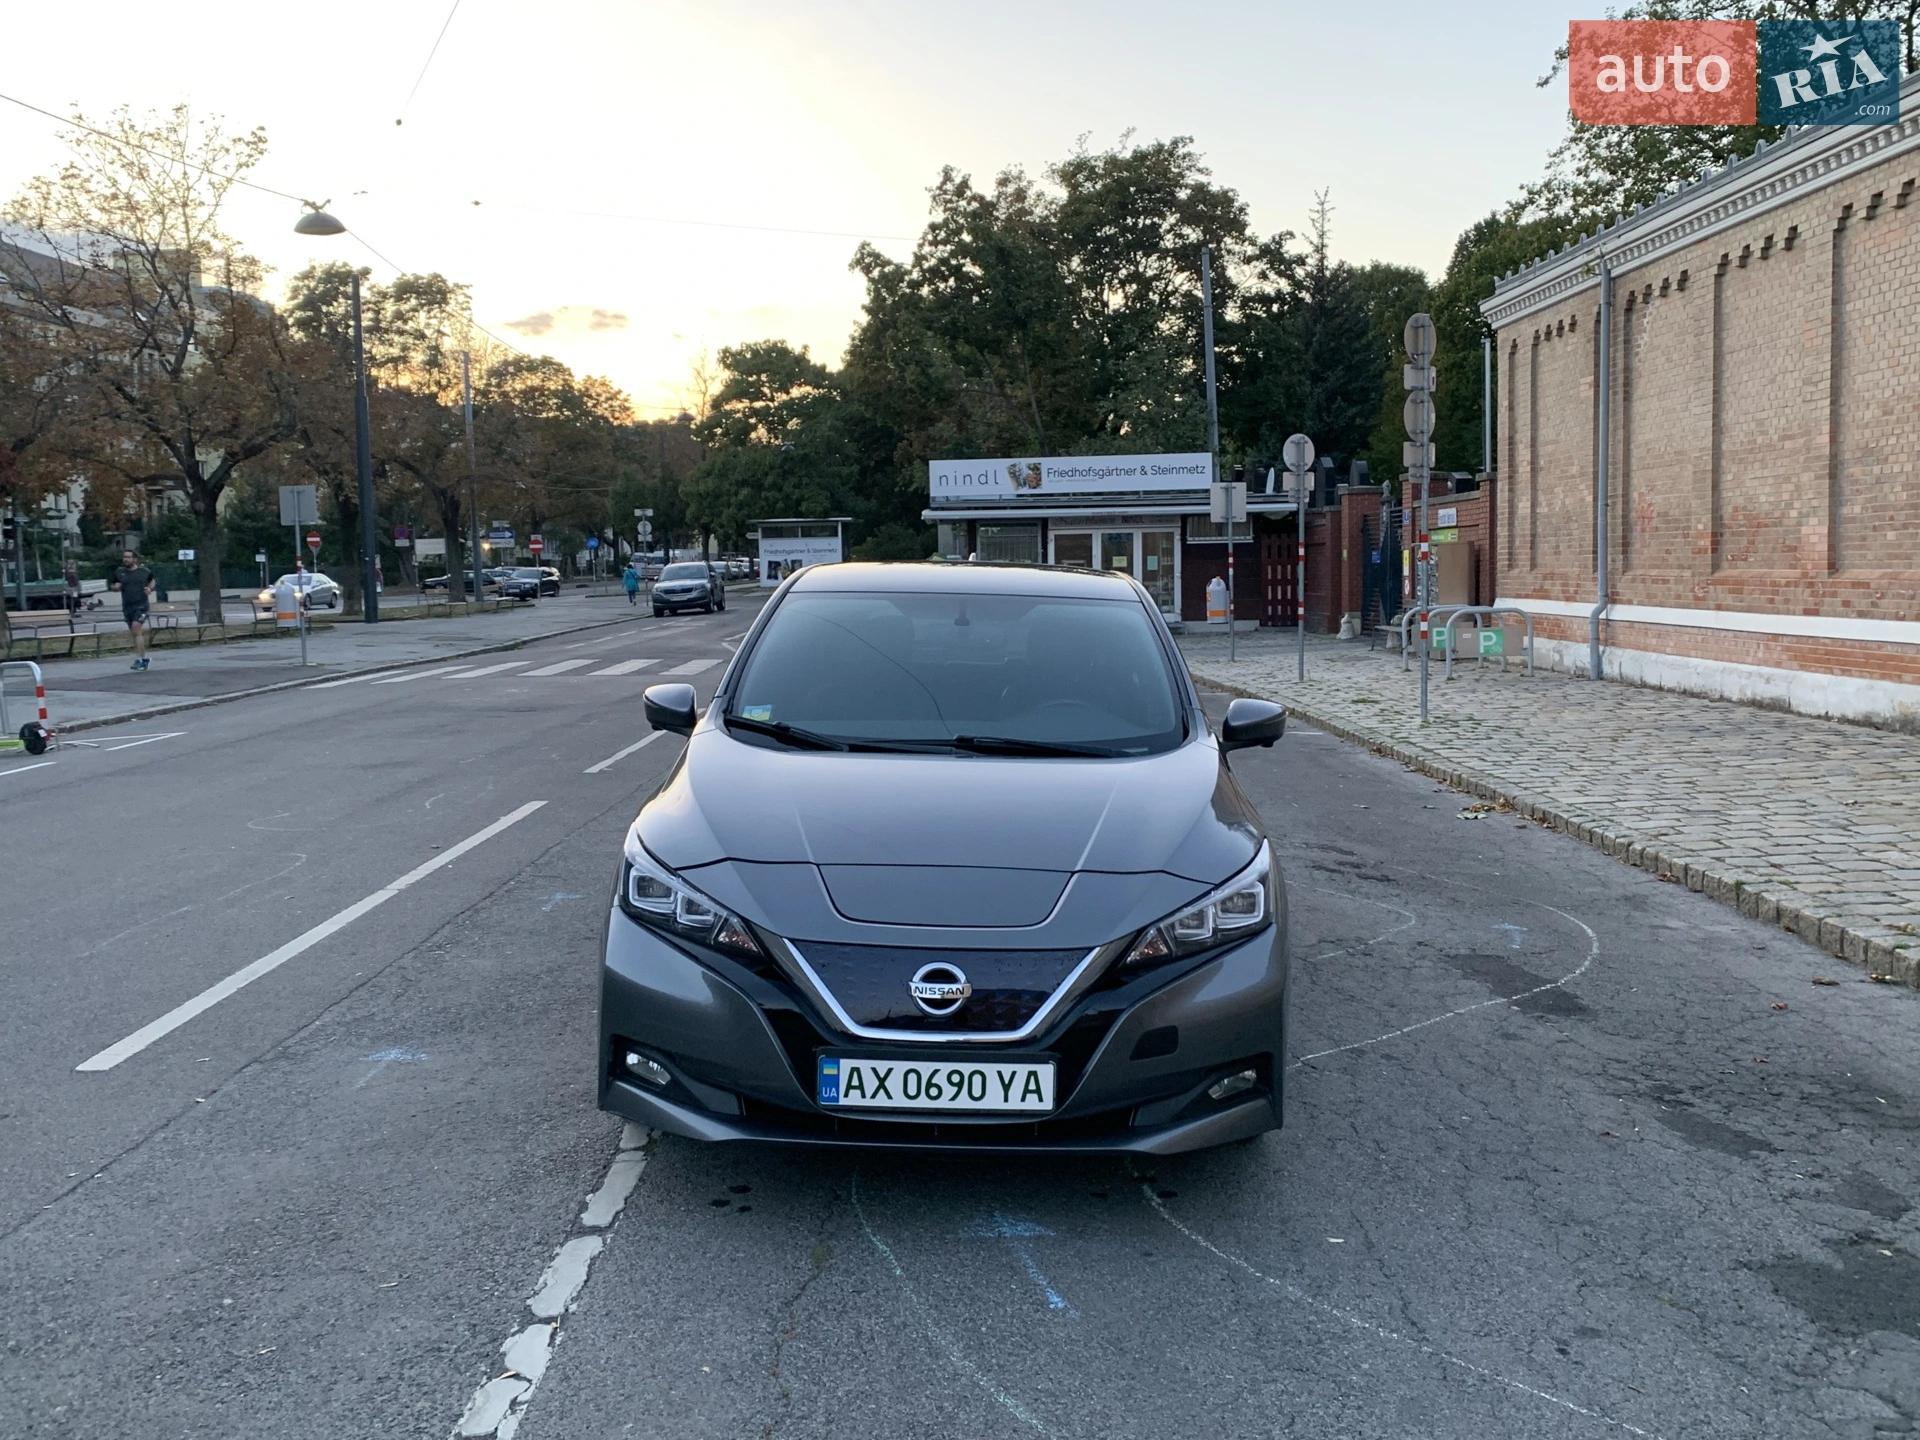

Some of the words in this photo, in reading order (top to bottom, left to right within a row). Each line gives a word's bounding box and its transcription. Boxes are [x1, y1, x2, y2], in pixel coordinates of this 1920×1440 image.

[939, 469, 999, 486] nindl
[1047, 466, 1137, 480] Friedhofsgärtner
[1140, 465, 1148, 476] &
[1150, 464, 1206, 476] Steinmetz
[1479, 631, 1497, 654] P
[914, 986, 965, 996] NISSAN
[822, 1087, 838, 1098] UA
[843, 1067, 894, 1100] AX
[902, 1068, 987, 1102] 0690
[996, 1070, 1044, 1103] YA
